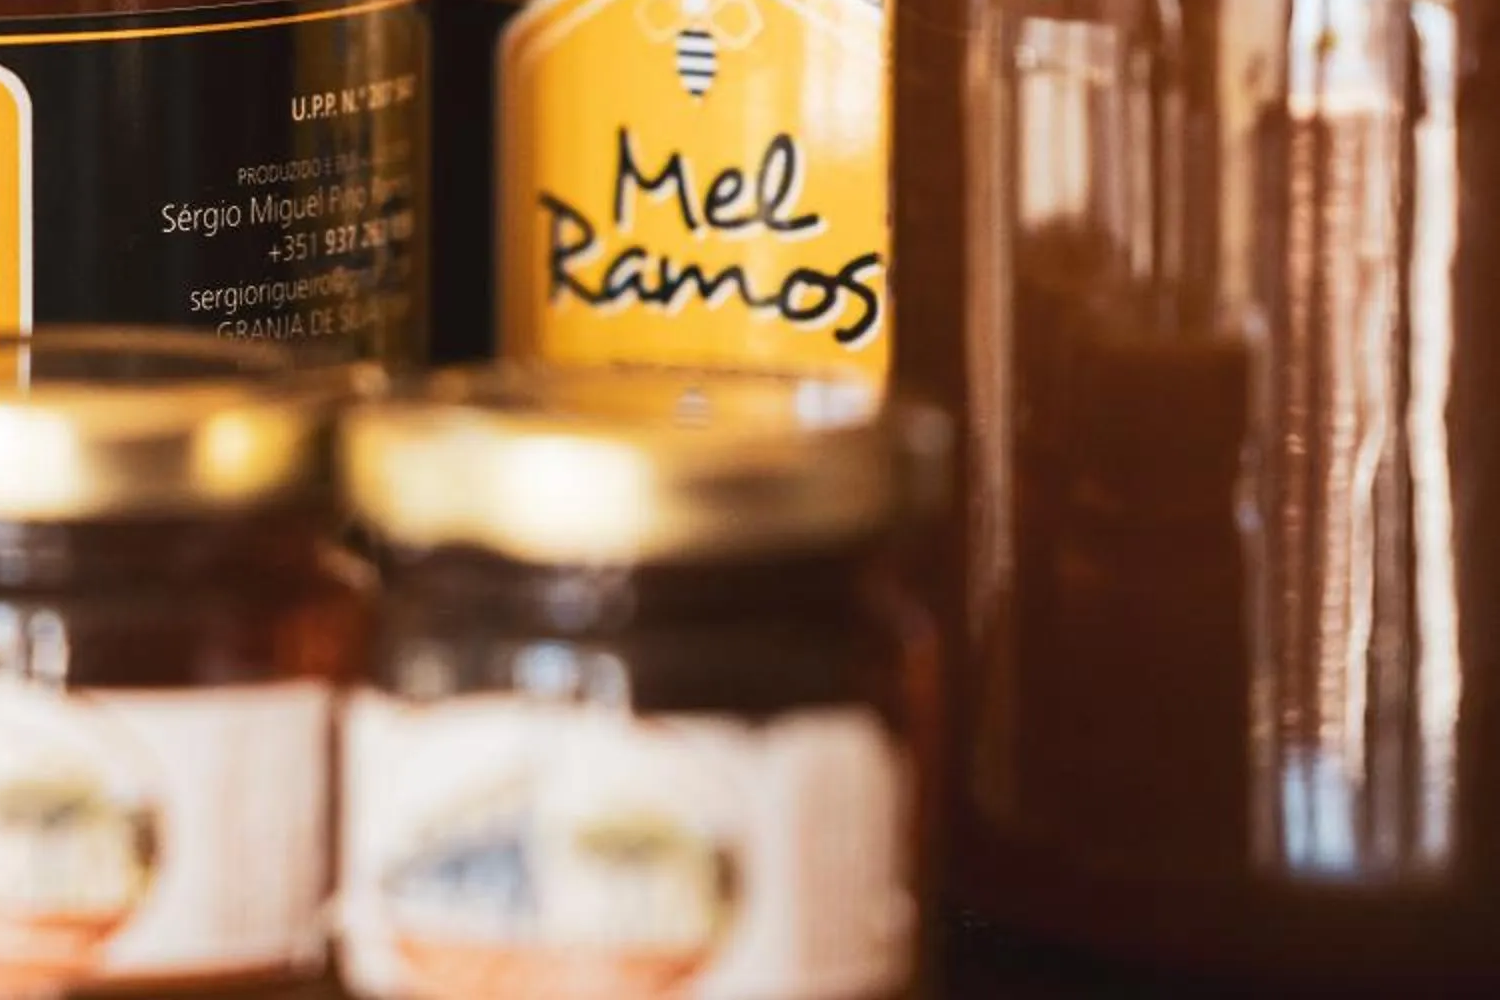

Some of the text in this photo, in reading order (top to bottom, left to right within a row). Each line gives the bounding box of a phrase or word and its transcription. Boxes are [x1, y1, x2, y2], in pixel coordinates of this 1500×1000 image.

[291, 91, 338, 121] U.P.P.
[614, 125, 819, 231] Mel
[161, 199, 242, 238] Sérgio
[250, 187, 324, 229] Miguel
[269, 232, 318, 264] +351
[325, 225, 356, 256] 937
[538, 190, 883, 342] Ramos
[216, 314, 304, 342] GRANJA
